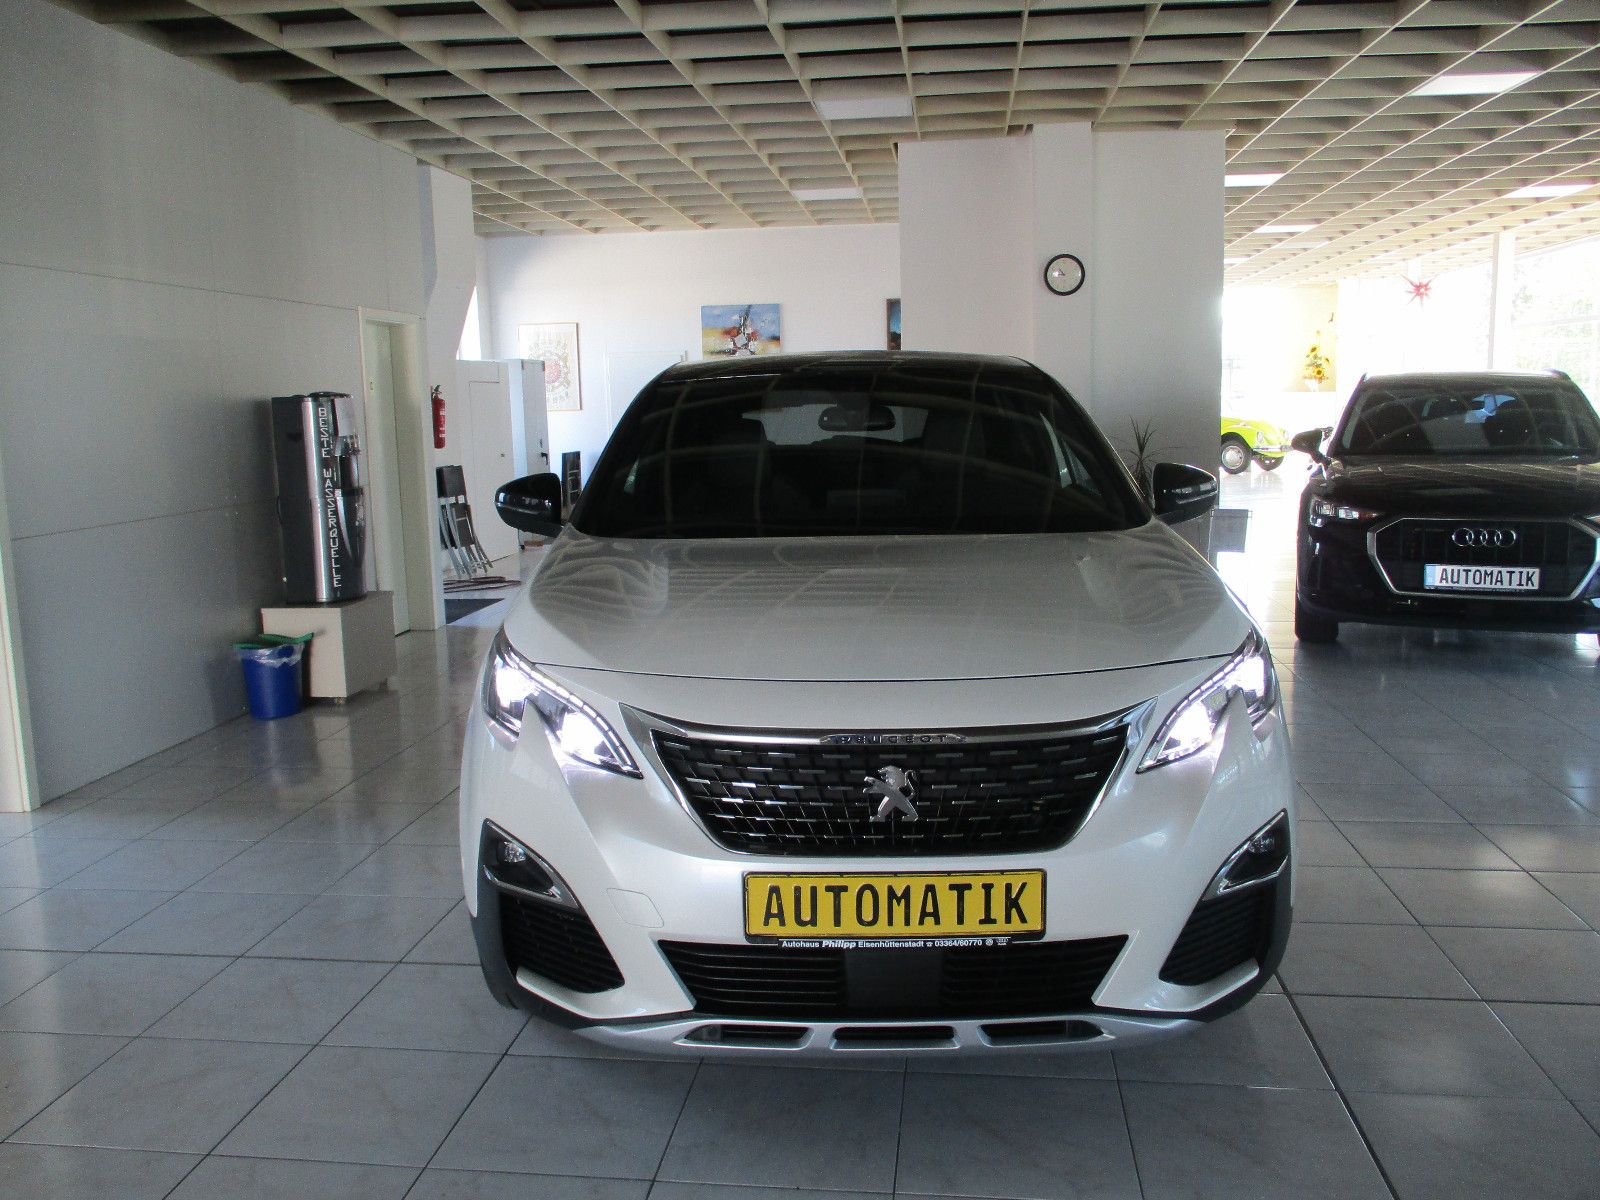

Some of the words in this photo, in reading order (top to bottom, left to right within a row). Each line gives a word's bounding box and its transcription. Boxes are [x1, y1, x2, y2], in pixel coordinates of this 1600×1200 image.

[318, 407, 331, 458] BESTE
[323, 468, 342, 588] WASSERQUELLE
[1439, 568, 1536, 587] AUTOMATIK
[840, 734, 946, 744] PEUGEOT
[762, 882, 1029, 927] AUTOMATIK
[782, 940, 820, 948] Autohaus
[821, 940, 857, 949] Philipp
[858, 939, 925, 948] Eisenhüttenstadt
